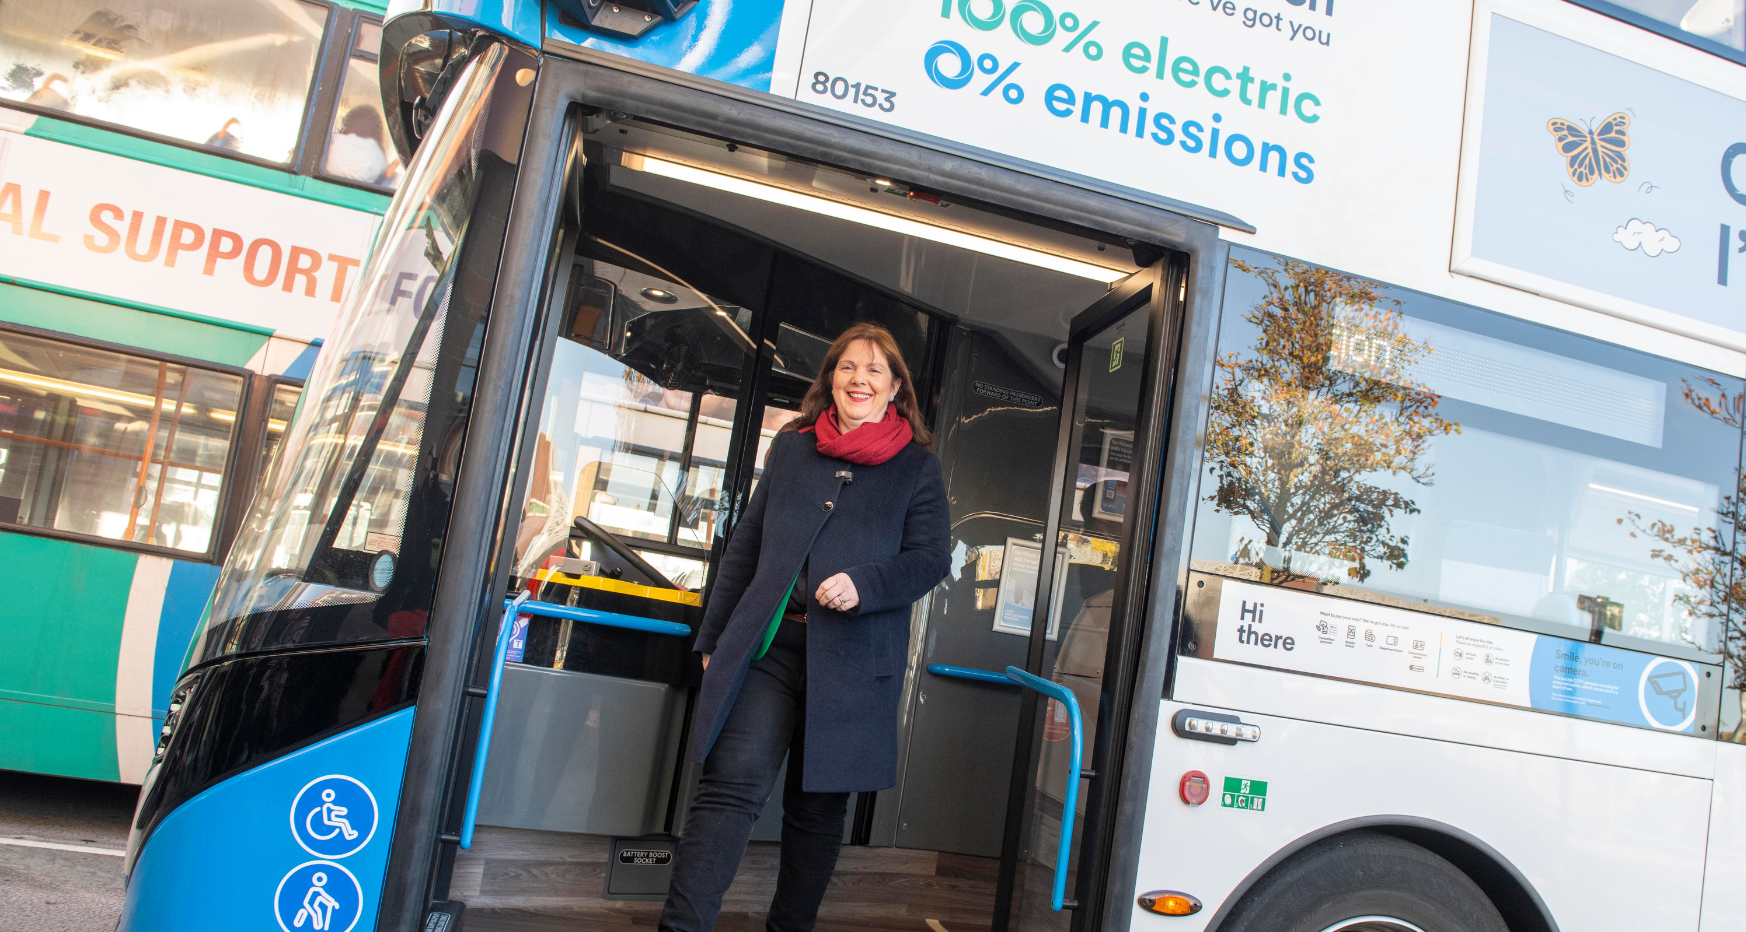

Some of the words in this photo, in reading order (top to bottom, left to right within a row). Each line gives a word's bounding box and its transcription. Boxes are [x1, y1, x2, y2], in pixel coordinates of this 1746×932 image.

[1242, 7, 1283, 32] got
[1289, 19, 1331, 47] you
[811, 71, 897, 113] 80153
[1122, 35, 1322, 124] electric
[924, 40, 1024, 105] 0%
[1044, 83, 1315, 184] emissions
[82, 202, 361, 304] SUPPORT
[976, 388, 1001, 398] FORWARD
[984, 384, 1009, 394] STANDING
[1010, 391, 1040, 402] PASSENGERS
[1240, 600, 1265, 624] Hi
[1236, 624, 1295, 651] there
[1554, 664, 1589, 677] camera.
[1555, 650, 1582, 664] Smile,
[1584, 656, 1610, 668] you're
[1612, 662, 1624, 670] on
